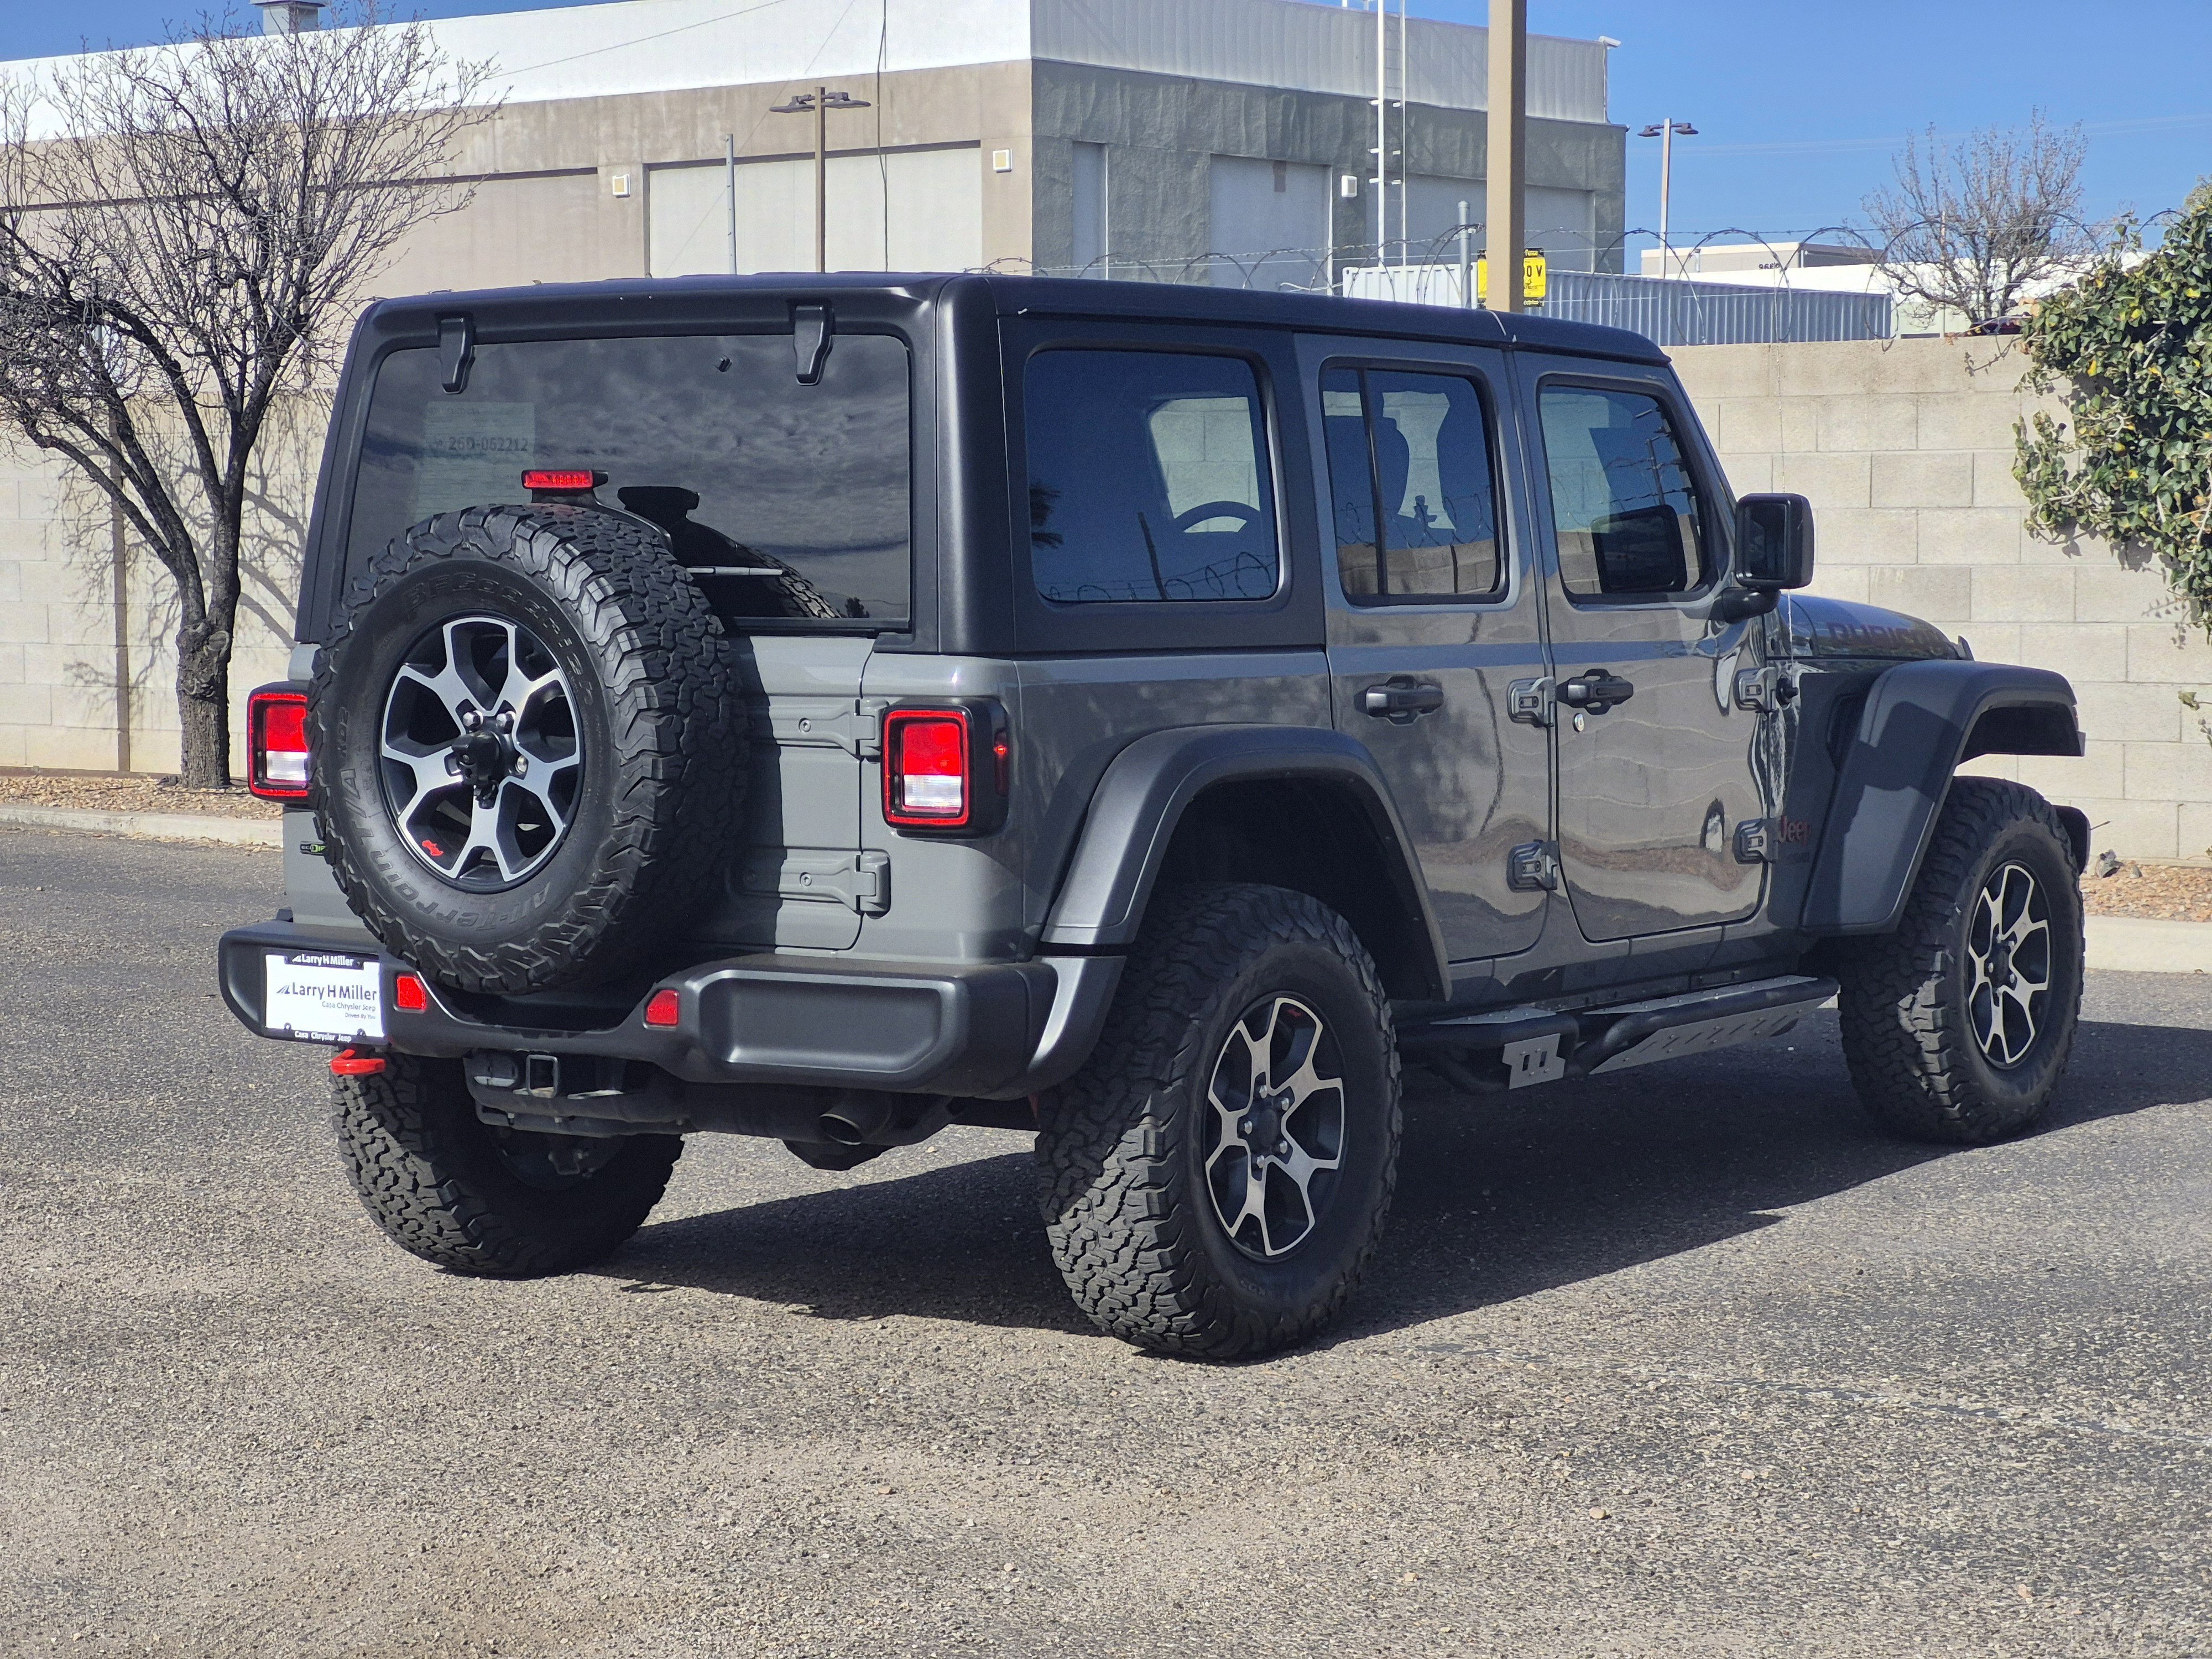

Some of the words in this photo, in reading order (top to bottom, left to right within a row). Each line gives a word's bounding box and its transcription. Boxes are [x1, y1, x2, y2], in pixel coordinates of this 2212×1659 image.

[301, 954, 322, 966] Larry
[322, 956, 330, 964] H
[330, 955, 354, 966] Miller
[292, 982, 325, 1000] Larry
[327, 984, 336, 998] H
[339, 985, 377, 1001] Miller
[337, 1002, 361, 1011] Chrysler
[362, 1004, 376, 1013] Jeep
[294, 1030, 309, 1039] Casa
[311, 1031, 336, 1041] Chrysler
[337, 1033, 352, 1043] Jeep
